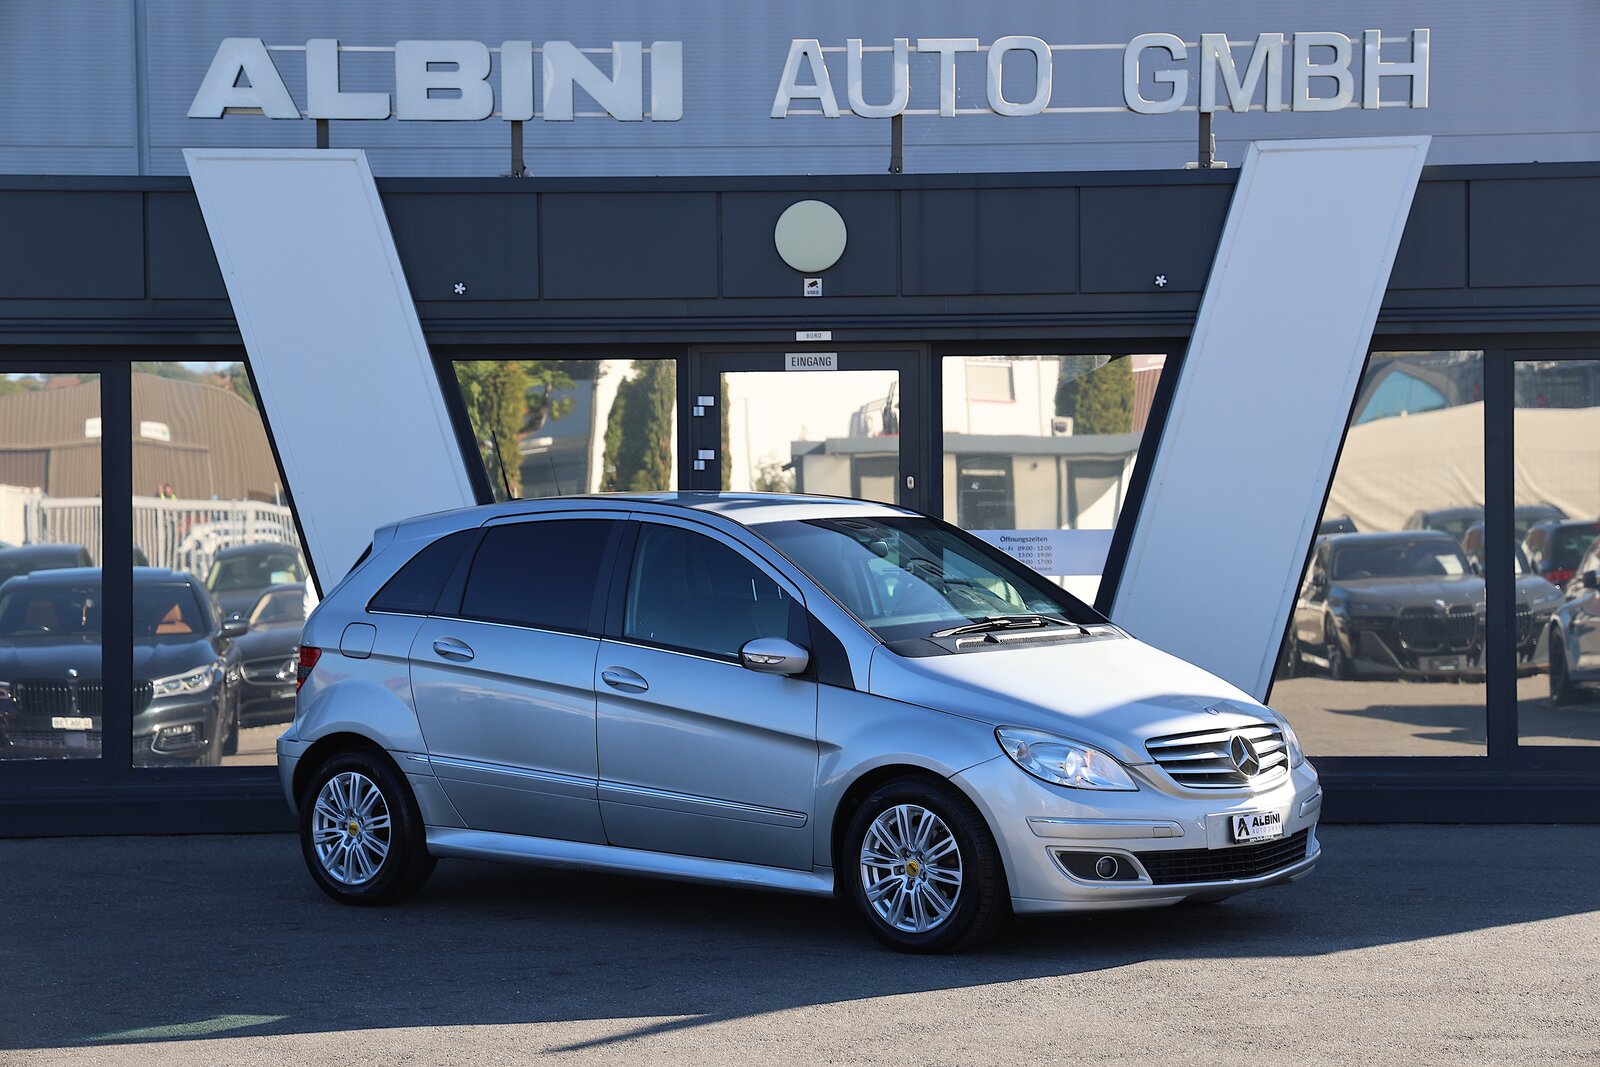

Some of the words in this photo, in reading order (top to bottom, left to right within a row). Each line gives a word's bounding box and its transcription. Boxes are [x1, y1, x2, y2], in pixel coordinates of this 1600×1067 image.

[187, 37, 683, 122] ALBINI
[770, 35, 1053, 119] AUTO
[1121, 28, 1430, 115] GMBH
[791, 356, 832, 367] EINGANG
[1000, 535, 1048, 543] Öffnungszeiten
[1252, 813, 1281, 828] ALBINI
[1252, 826, 1267, 834] AUTO
